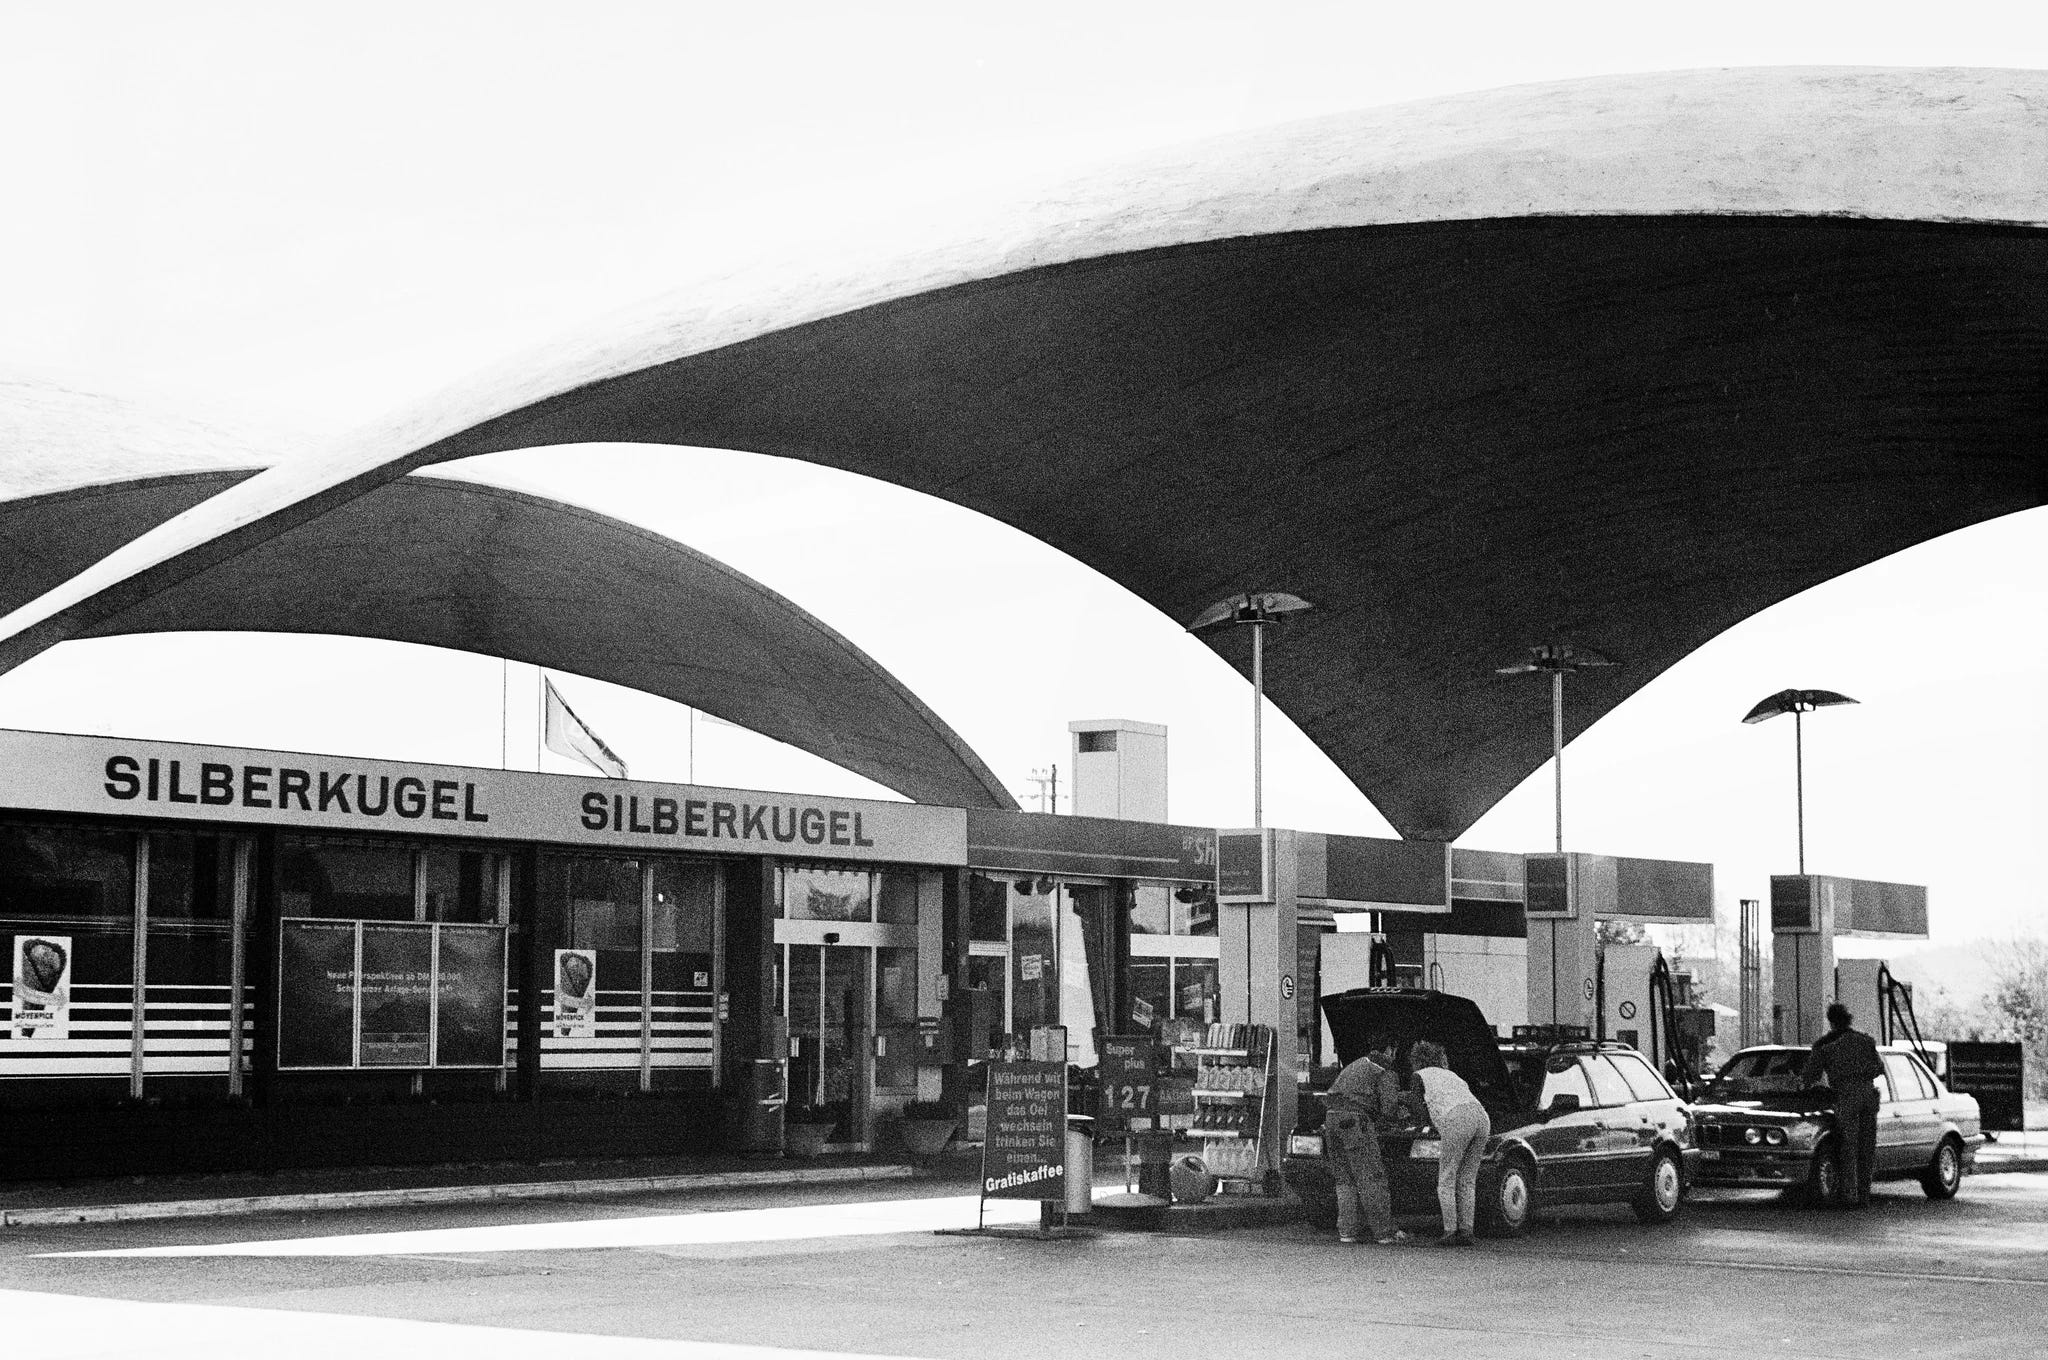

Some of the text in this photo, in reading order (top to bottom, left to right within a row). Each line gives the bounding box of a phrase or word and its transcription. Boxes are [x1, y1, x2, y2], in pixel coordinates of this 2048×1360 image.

[104, 755, 489, 823] SILBERKUGEL
[580, 791, 874, 848] SILBERKUGEL
[1194, 836, 1216, 865] Sh
[1106, 1042, 1135, 1056] Super
[994, 1071, 1061, 1085] Während wir
[995, 1087, 1060, 1102] beim Wagen
[1105, 1085, 1150, 1109] 127
[1006, 1103, 1048, 1116] das Oel
[1000, 1118, 1053, 1132] wechseln
[995, 1135, 1055, 1148] trinken Sie
[985, 1164, 1063, 1192] Gratiskaffee
